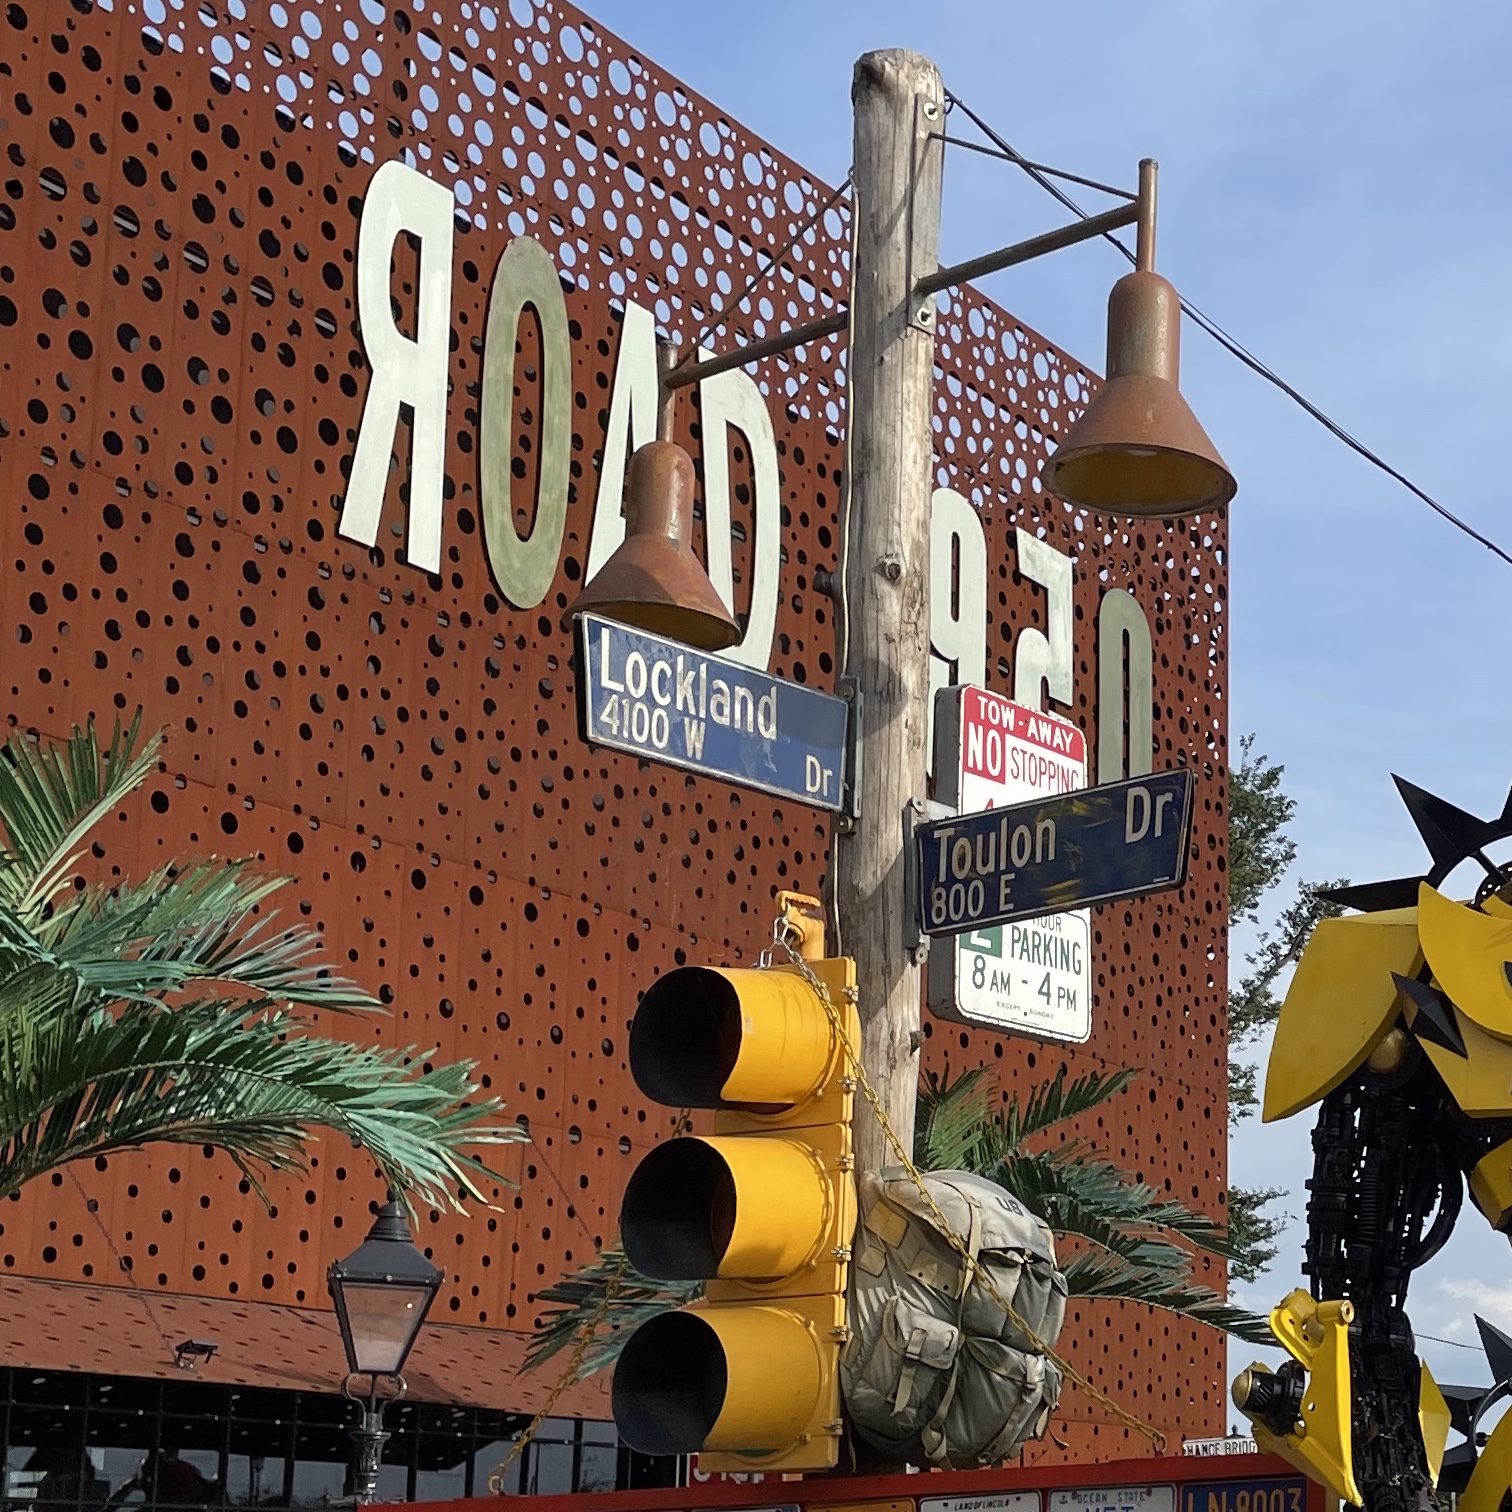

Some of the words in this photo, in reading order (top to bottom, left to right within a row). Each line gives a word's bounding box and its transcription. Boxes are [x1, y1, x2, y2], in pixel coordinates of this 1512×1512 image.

[601, 627, 777, 741] Lockland
[600, 694, 669, 749] 4100
[684, 717, 706, 760] W
[806, 755, 833, 797] Dr
[967, 721, 1003, 776] NO
[933, 817, 1056, 882] Toulon
[1125, 786, 1173, 844] Dr
[931, 879, 985, 925] 800
[999, 873, 1016, 912] E
[1011, 924, 1081, 975] PARKING
[972, 954, 986, 989] 8
[990, 969, 1011, 996] AM
[1038, 972, 1051, 1005] 4
[1057, 986, 1076, 1012] PM
[1225, 1441, 1257, 1454] BRIDG
